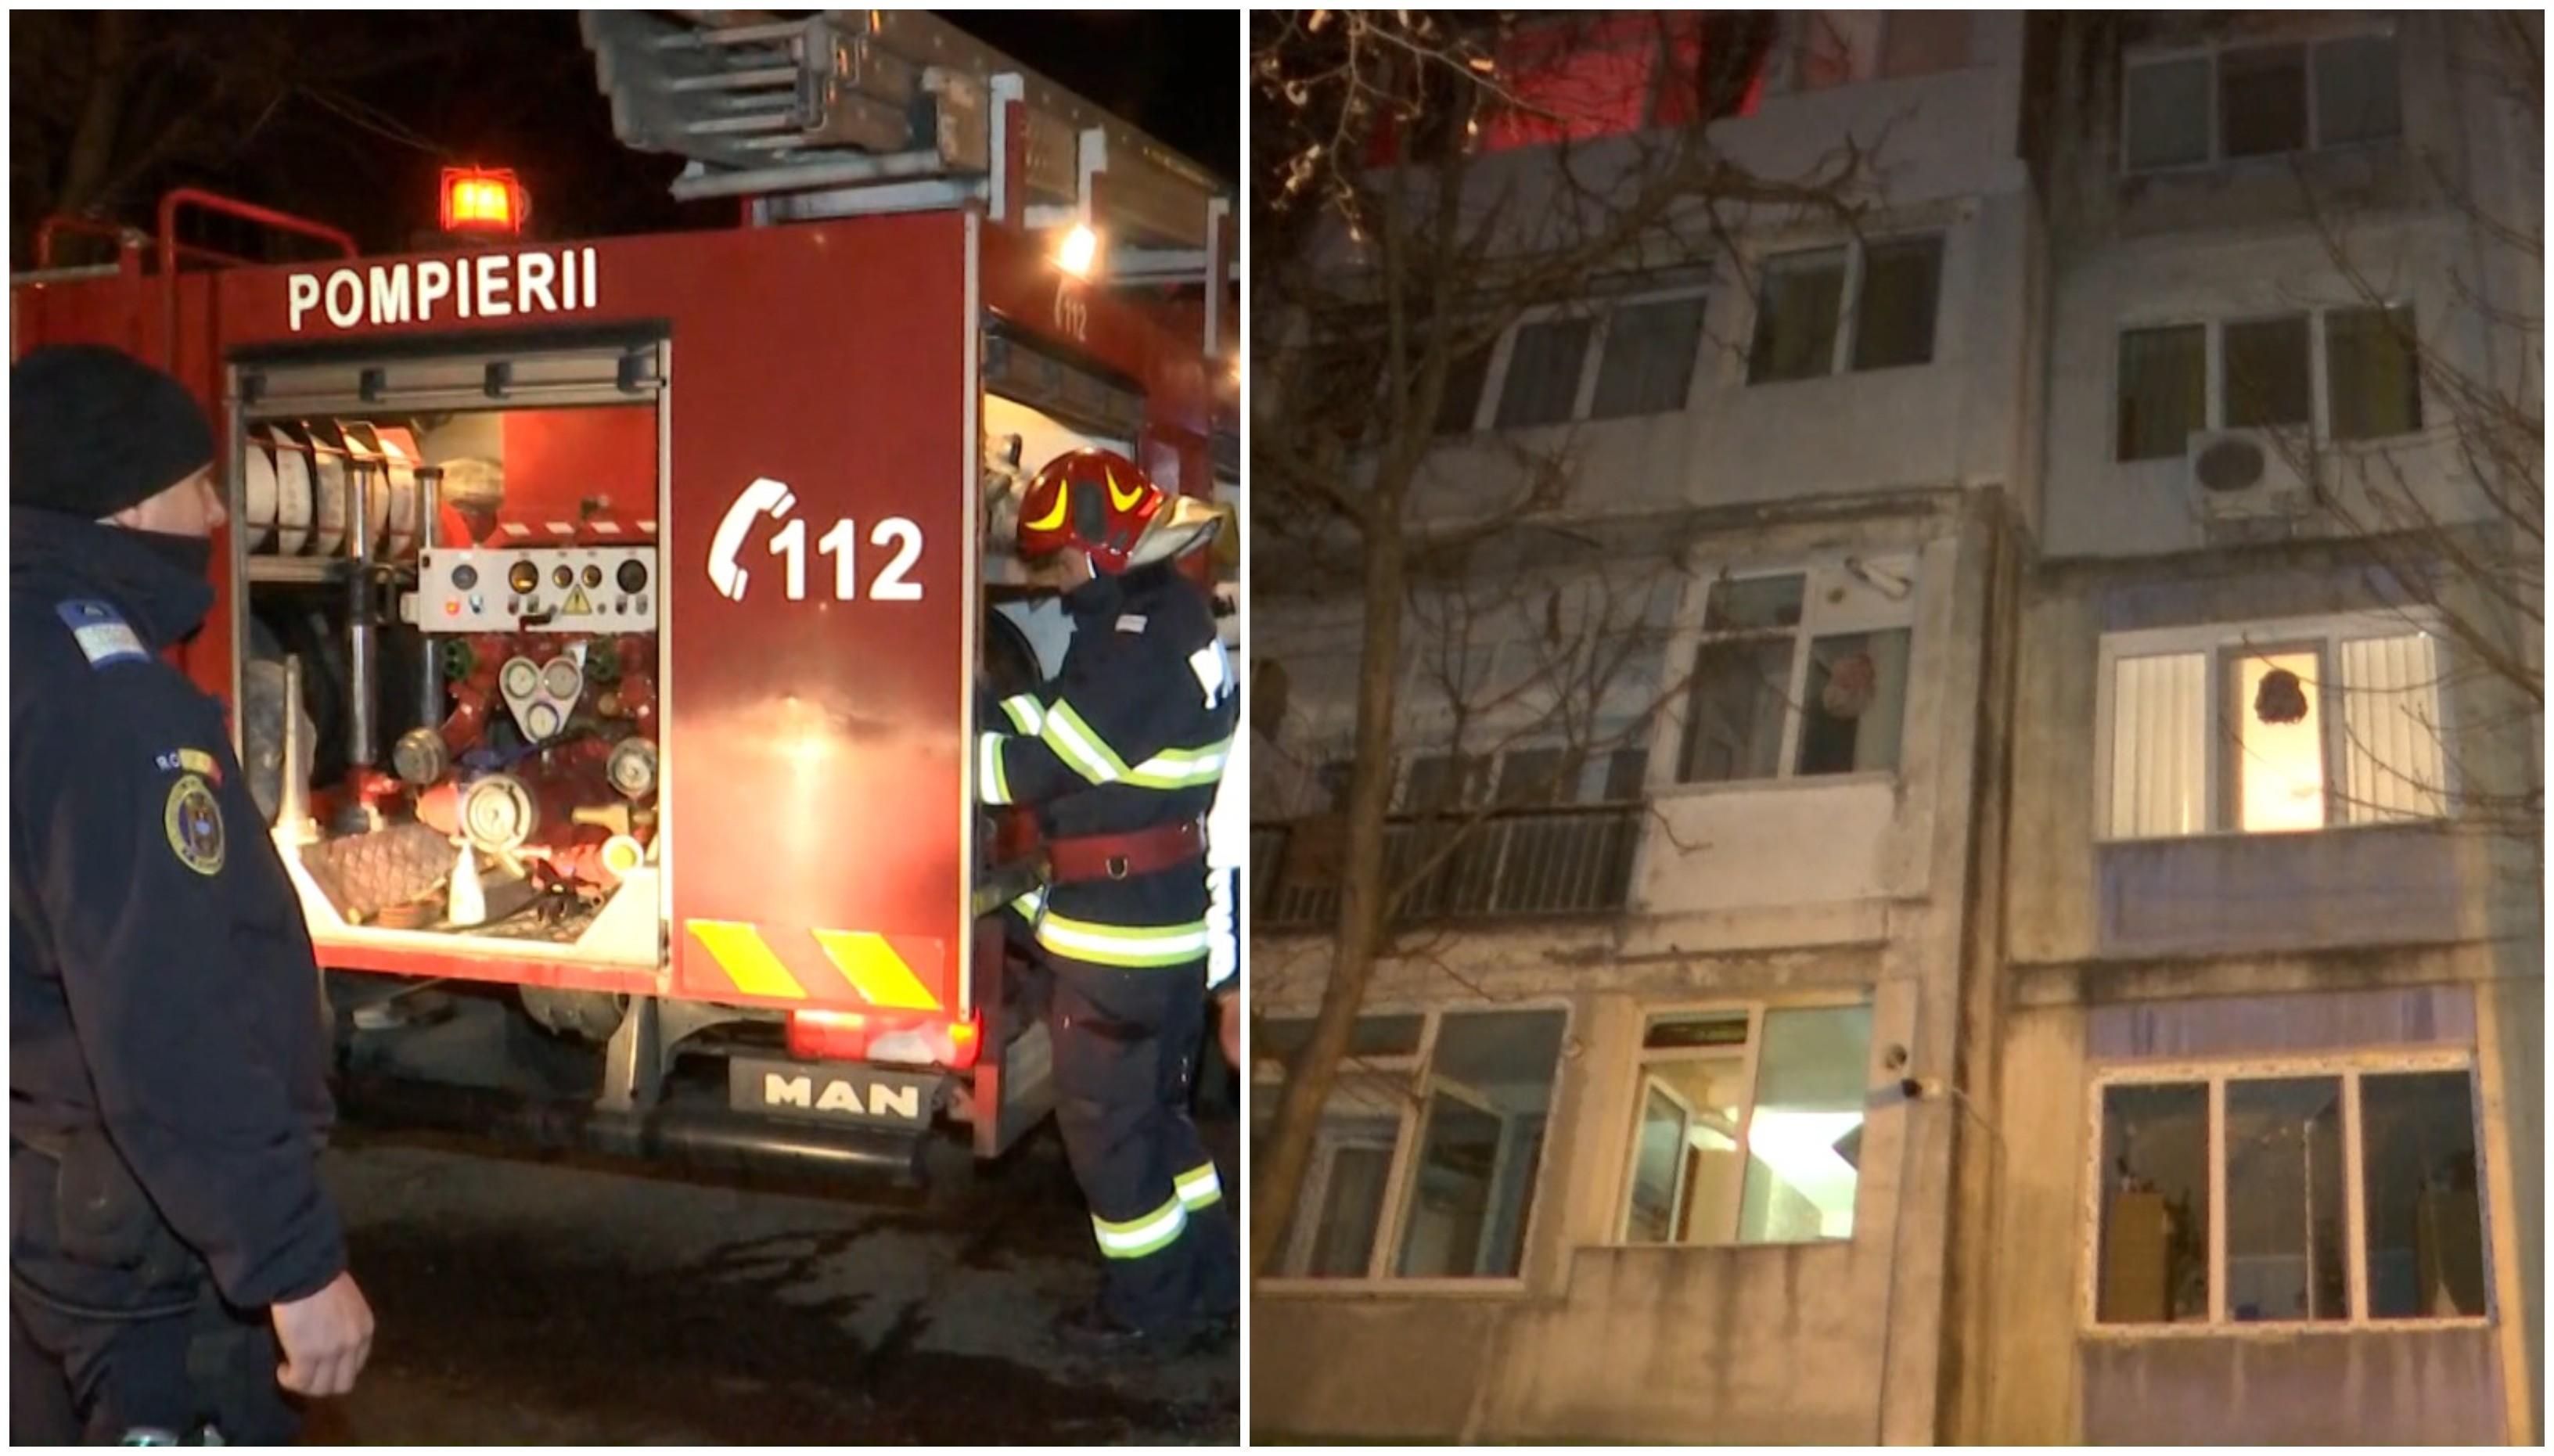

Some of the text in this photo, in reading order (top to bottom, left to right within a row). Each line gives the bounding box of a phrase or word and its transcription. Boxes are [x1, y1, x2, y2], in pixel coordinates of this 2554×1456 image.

[289, 247, 596, 331] POMPIERII
[769, 516, 923, 600] 112
[764, 1073, 919, 1119] MAN
